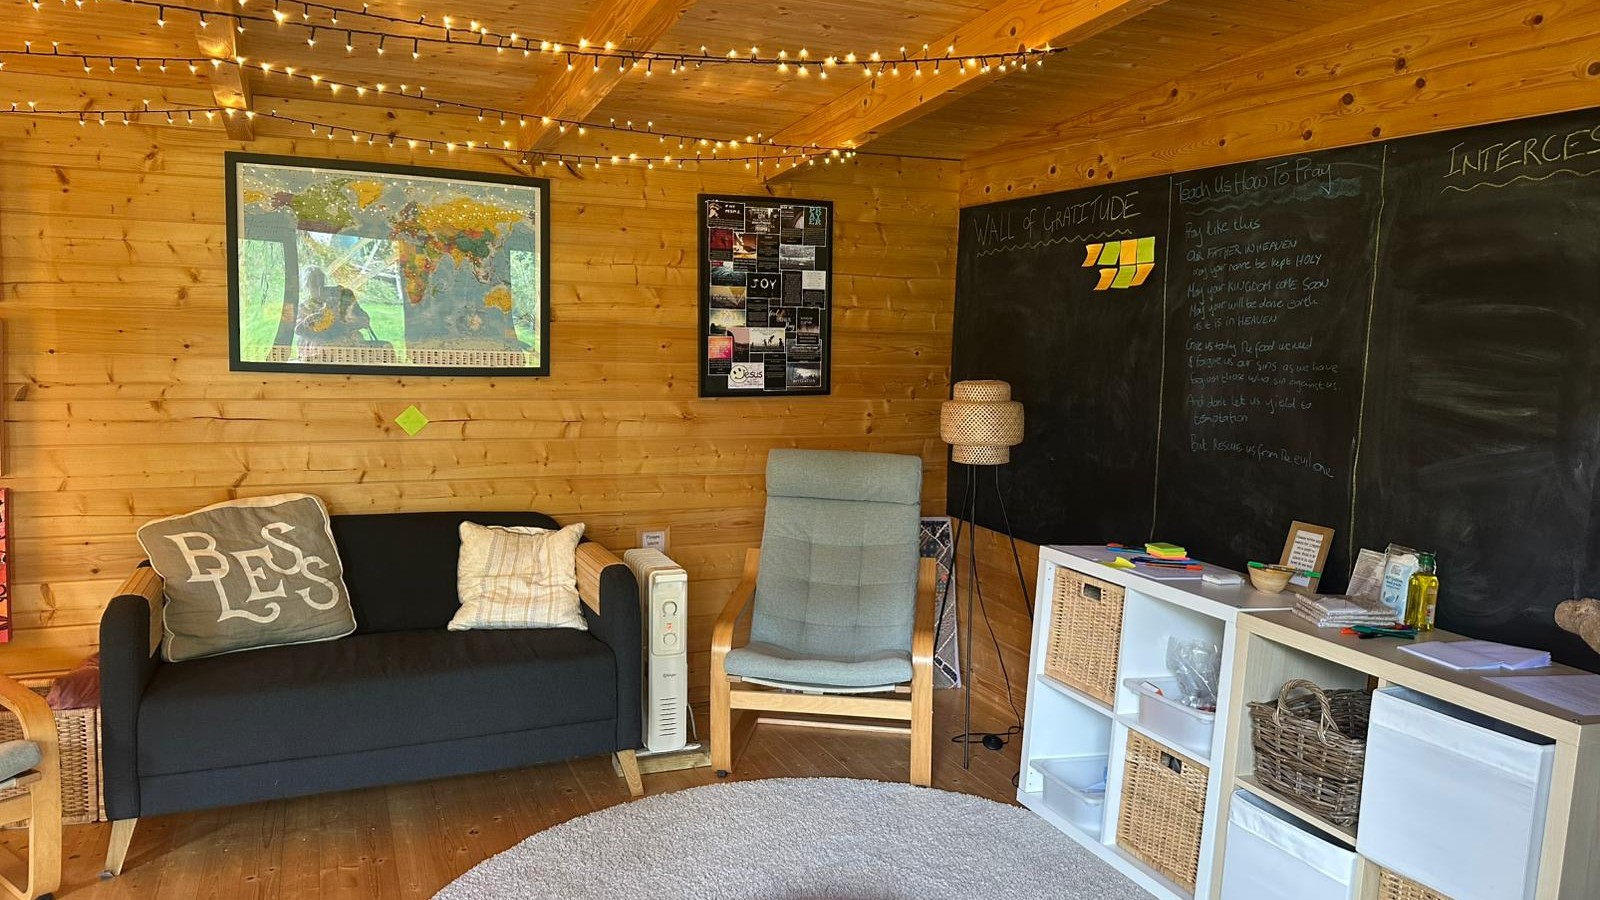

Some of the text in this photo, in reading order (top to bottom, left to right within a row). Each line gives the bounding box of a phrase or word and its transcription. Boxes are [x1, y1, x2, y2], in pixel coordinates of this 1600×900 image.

[1175, 157, 1332, 202] Teach Us How To Pray
[974, 212, 1015, 246] WALL
[1043, 191, 1142, 234] GRATITUDE
[1206, 219, 1229, 236] like
[1233, 216, 1261, 231] this
[1207, 244, 1241, 260] FATHER
[1256, 240, 1297, 254] HEAVEN
[1254, 258, 1267, 270] be
[1271, 257, 1292, 271] kept
[1295, 254, 1322, 268] HOLY
[750, 278, 777, 290] JOY
[1227, 279, 1272, 294] KINGDOM
[1228, 297, 1245, 310] will
[1245, 298, 1257, 309] be
[1258, 297, 1285, 309] done
[1225, 316, 1236, 327] in
[1236, 314, 1278, 328] HEAVEN
[1254, 339, 1275, 359] food
[1255, 360, 1278, 372] sins
[1311, 361, 1339, 374] have
[1186, 393, 1204, 408] And
[1231, 394, 1247, 408] let
[1249, 396, 1261, 406] us
[1245, 444, 1256, 456] us
[1257, 443, 1279, 462] from
[1293, 450, 1312, 468] evil
[1312, 462, 1336, 479] one
[163, 521, 340, 623] BLESS
